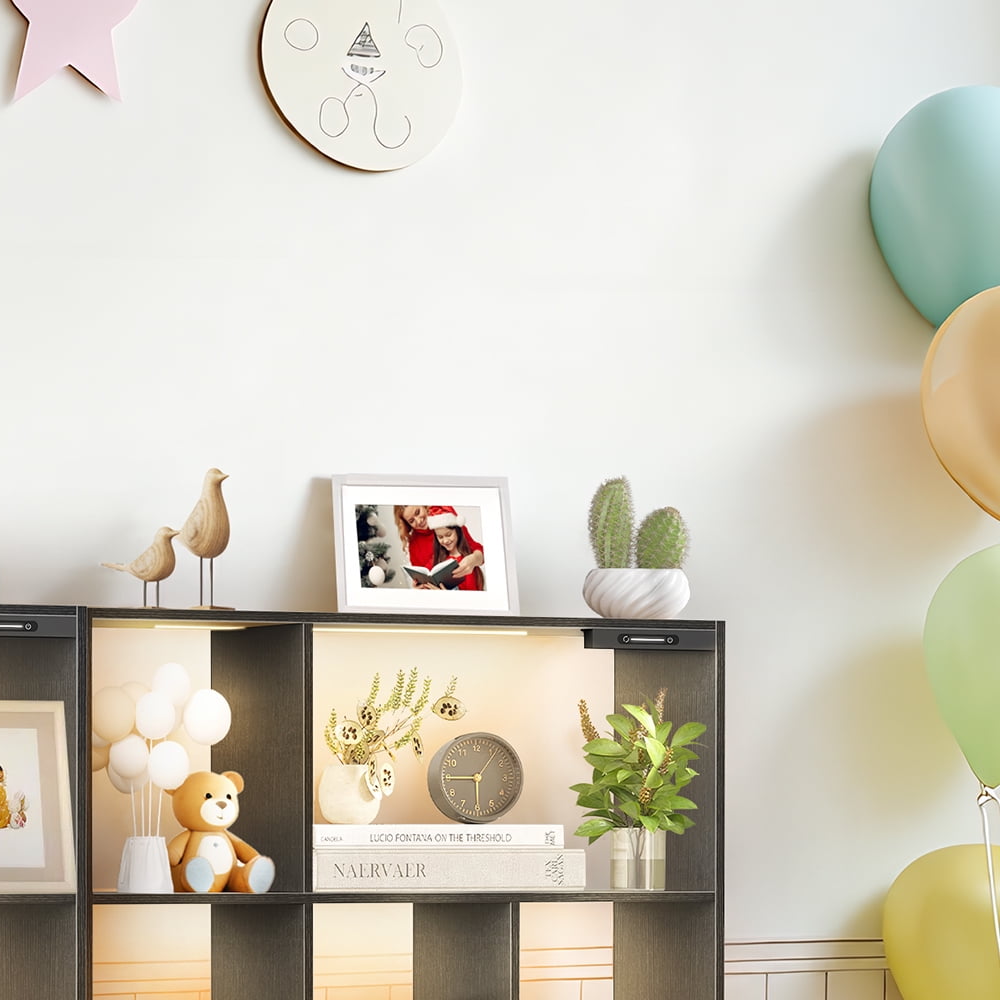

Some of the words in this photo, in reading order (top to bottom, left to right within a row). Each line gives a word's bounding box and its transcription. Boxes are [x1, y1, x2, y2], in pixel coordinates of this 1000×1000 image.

[448, 759, 457, 767] 10
[498, 760, 504, 768] 2
[449, 788, 456, 797] 8
[460, 799, 466, 808] 7
[369, 833, 393, 843] LUCIO
[434, 833, 447, 843] ON
[449, 833, 464, 843] THE
[466, 833, 513, 843] THRESHOLD
[333, 863, 427, 878] NAERVAER
